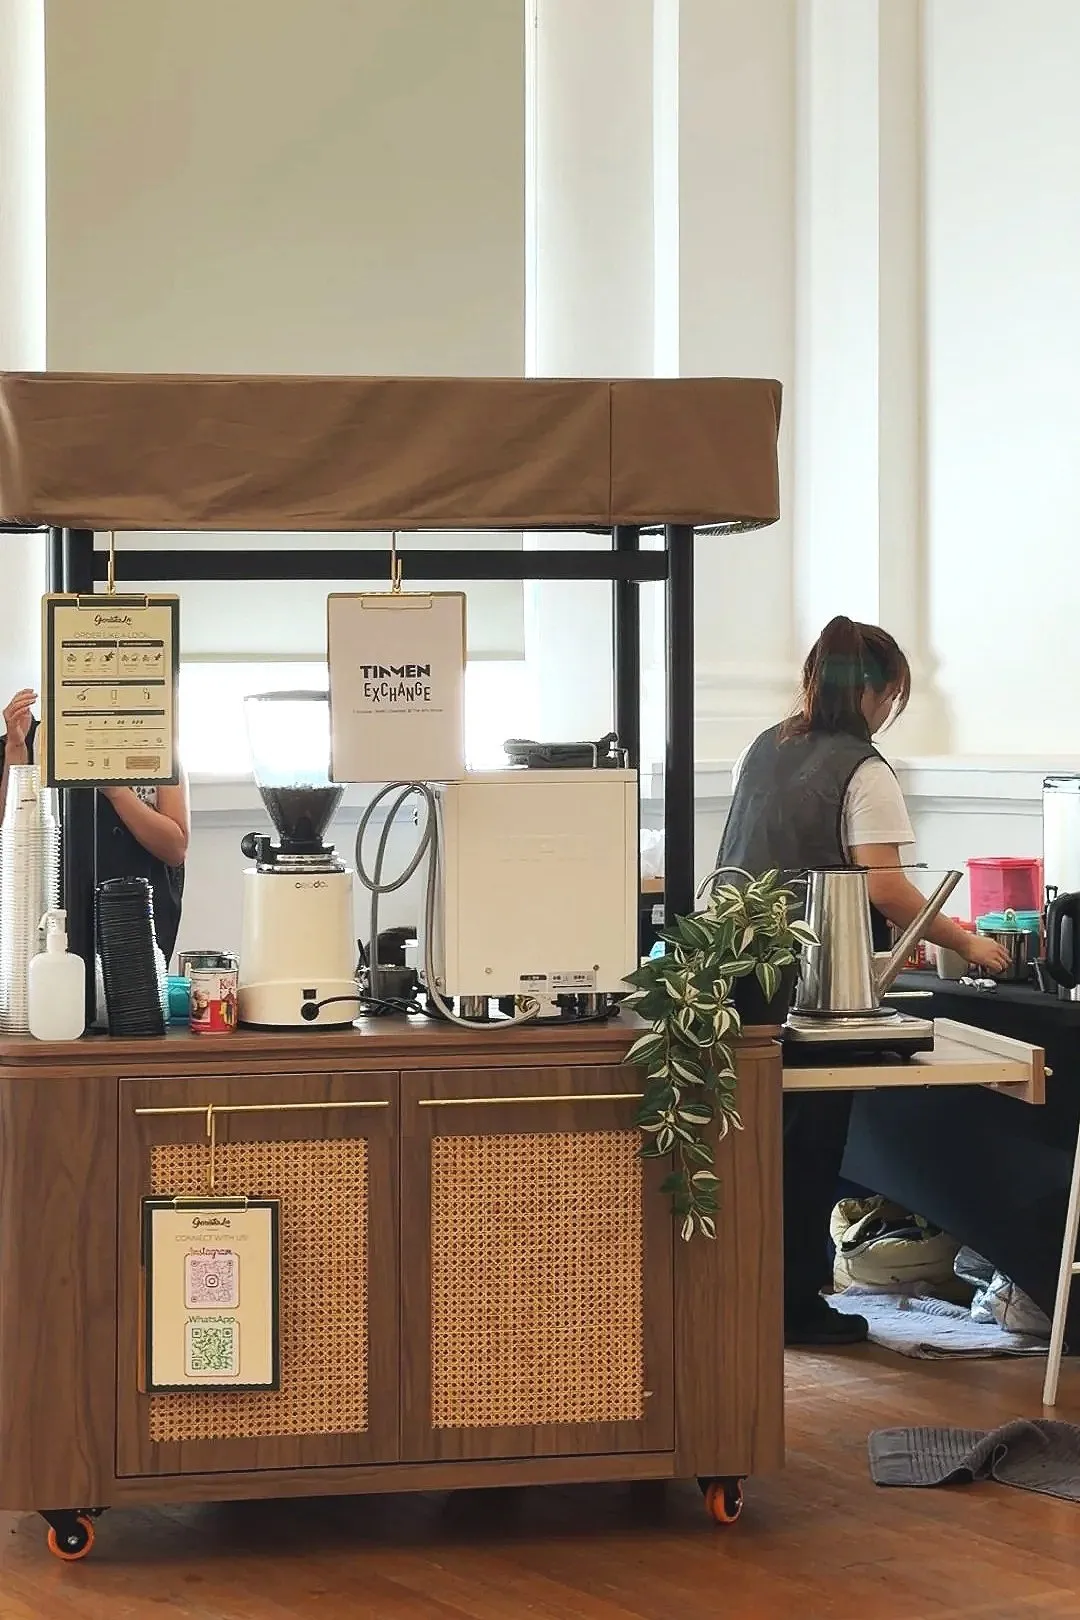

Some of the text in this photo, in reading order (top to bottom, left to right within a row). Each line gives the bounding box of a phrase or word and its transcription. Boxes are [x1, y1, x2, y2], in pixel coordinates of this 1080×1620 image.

[364, 681, 431, 702] EXCHANGE
[190, 1247, 233, 1260] Instagram
[188, 1315, 236, 1325] WhatsApp
